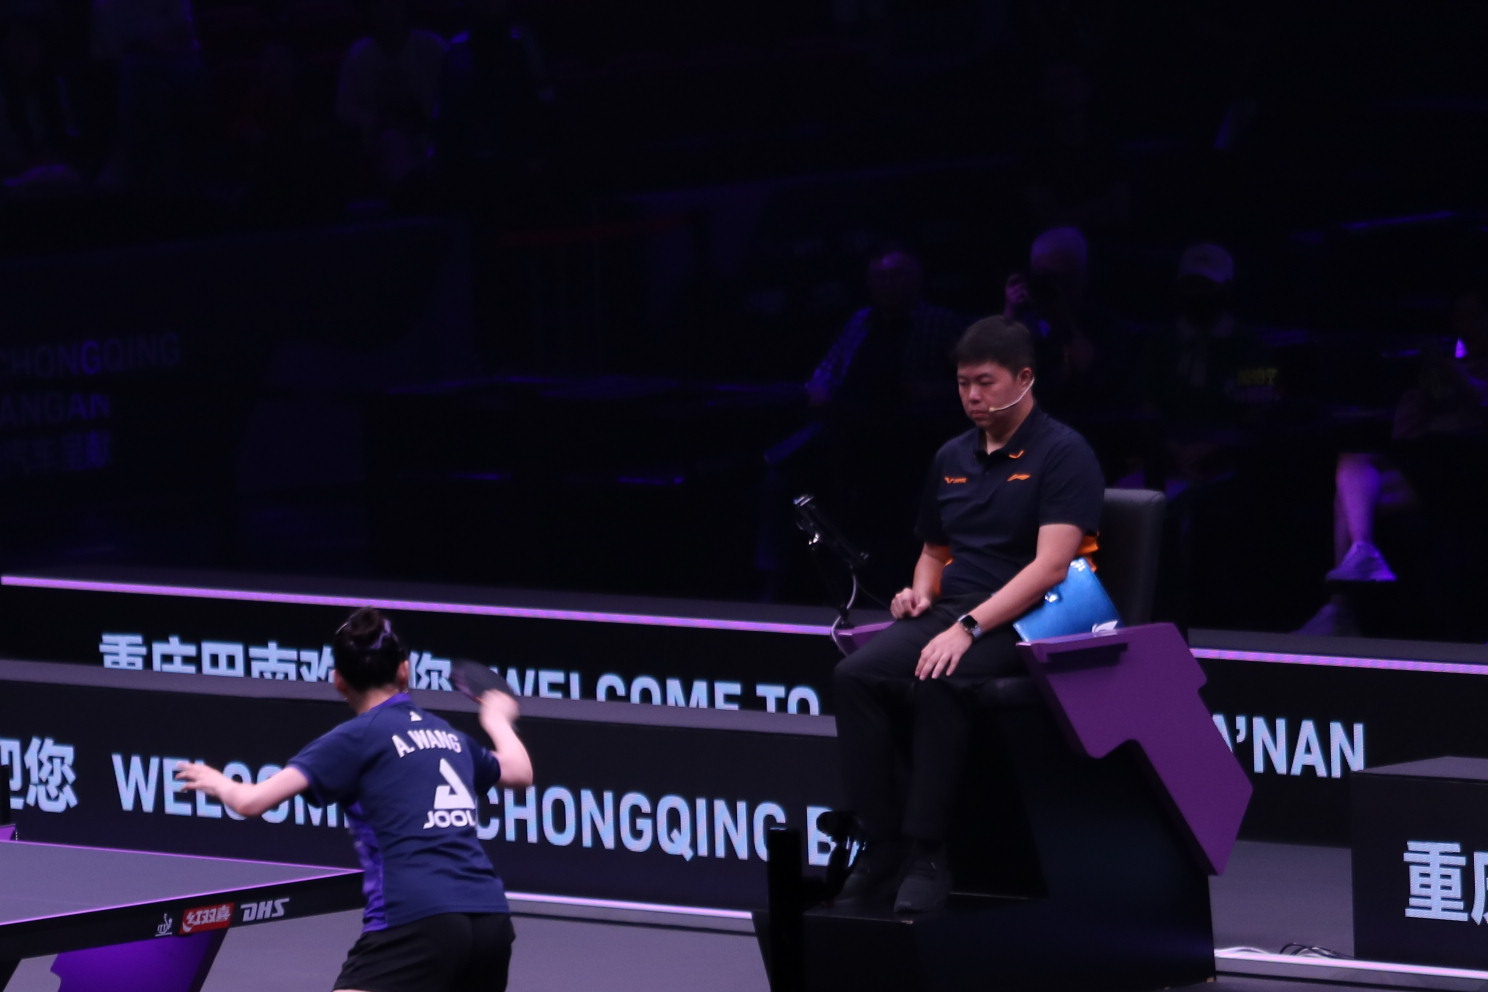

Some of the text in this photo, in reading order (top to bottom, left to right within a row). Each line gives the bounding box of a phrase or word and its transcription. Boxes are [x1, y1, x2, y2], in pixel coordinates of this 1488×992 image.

[1212, 713, 1365, 780] 'NAN
[111, 752, 350, 829] WELCO
[476, 785, 788, 862] CHONGQING
[423, 809, 476, 829] JOOL
[240, 897, 290, 922] DHS
